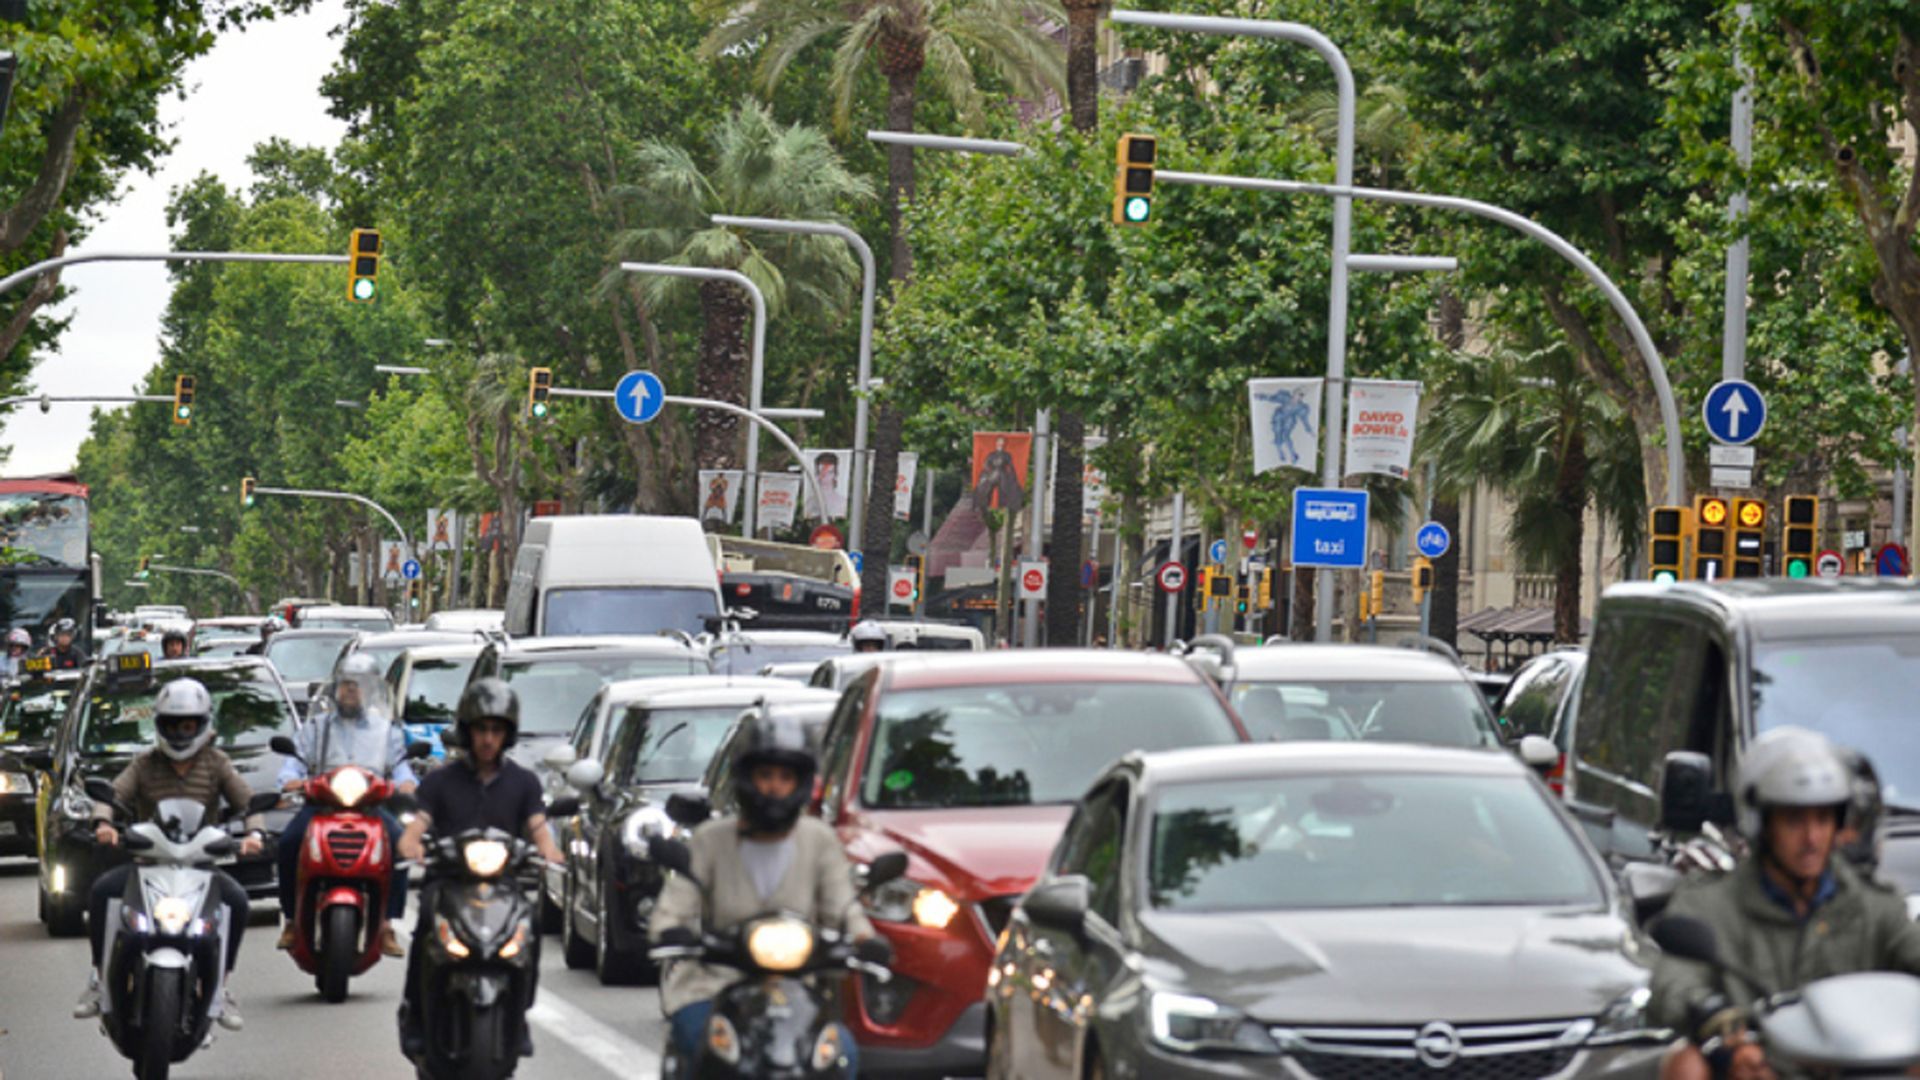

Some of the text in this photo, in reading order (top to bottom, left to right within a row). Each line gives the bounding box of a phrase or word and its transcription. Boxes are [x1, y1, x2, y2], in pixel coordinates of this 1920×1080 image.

[1359, 411, 1404, 424] DAVID
[1352, 424, 1395, 436] BOWIE
[1314, 538, 1345, 555] taxi
